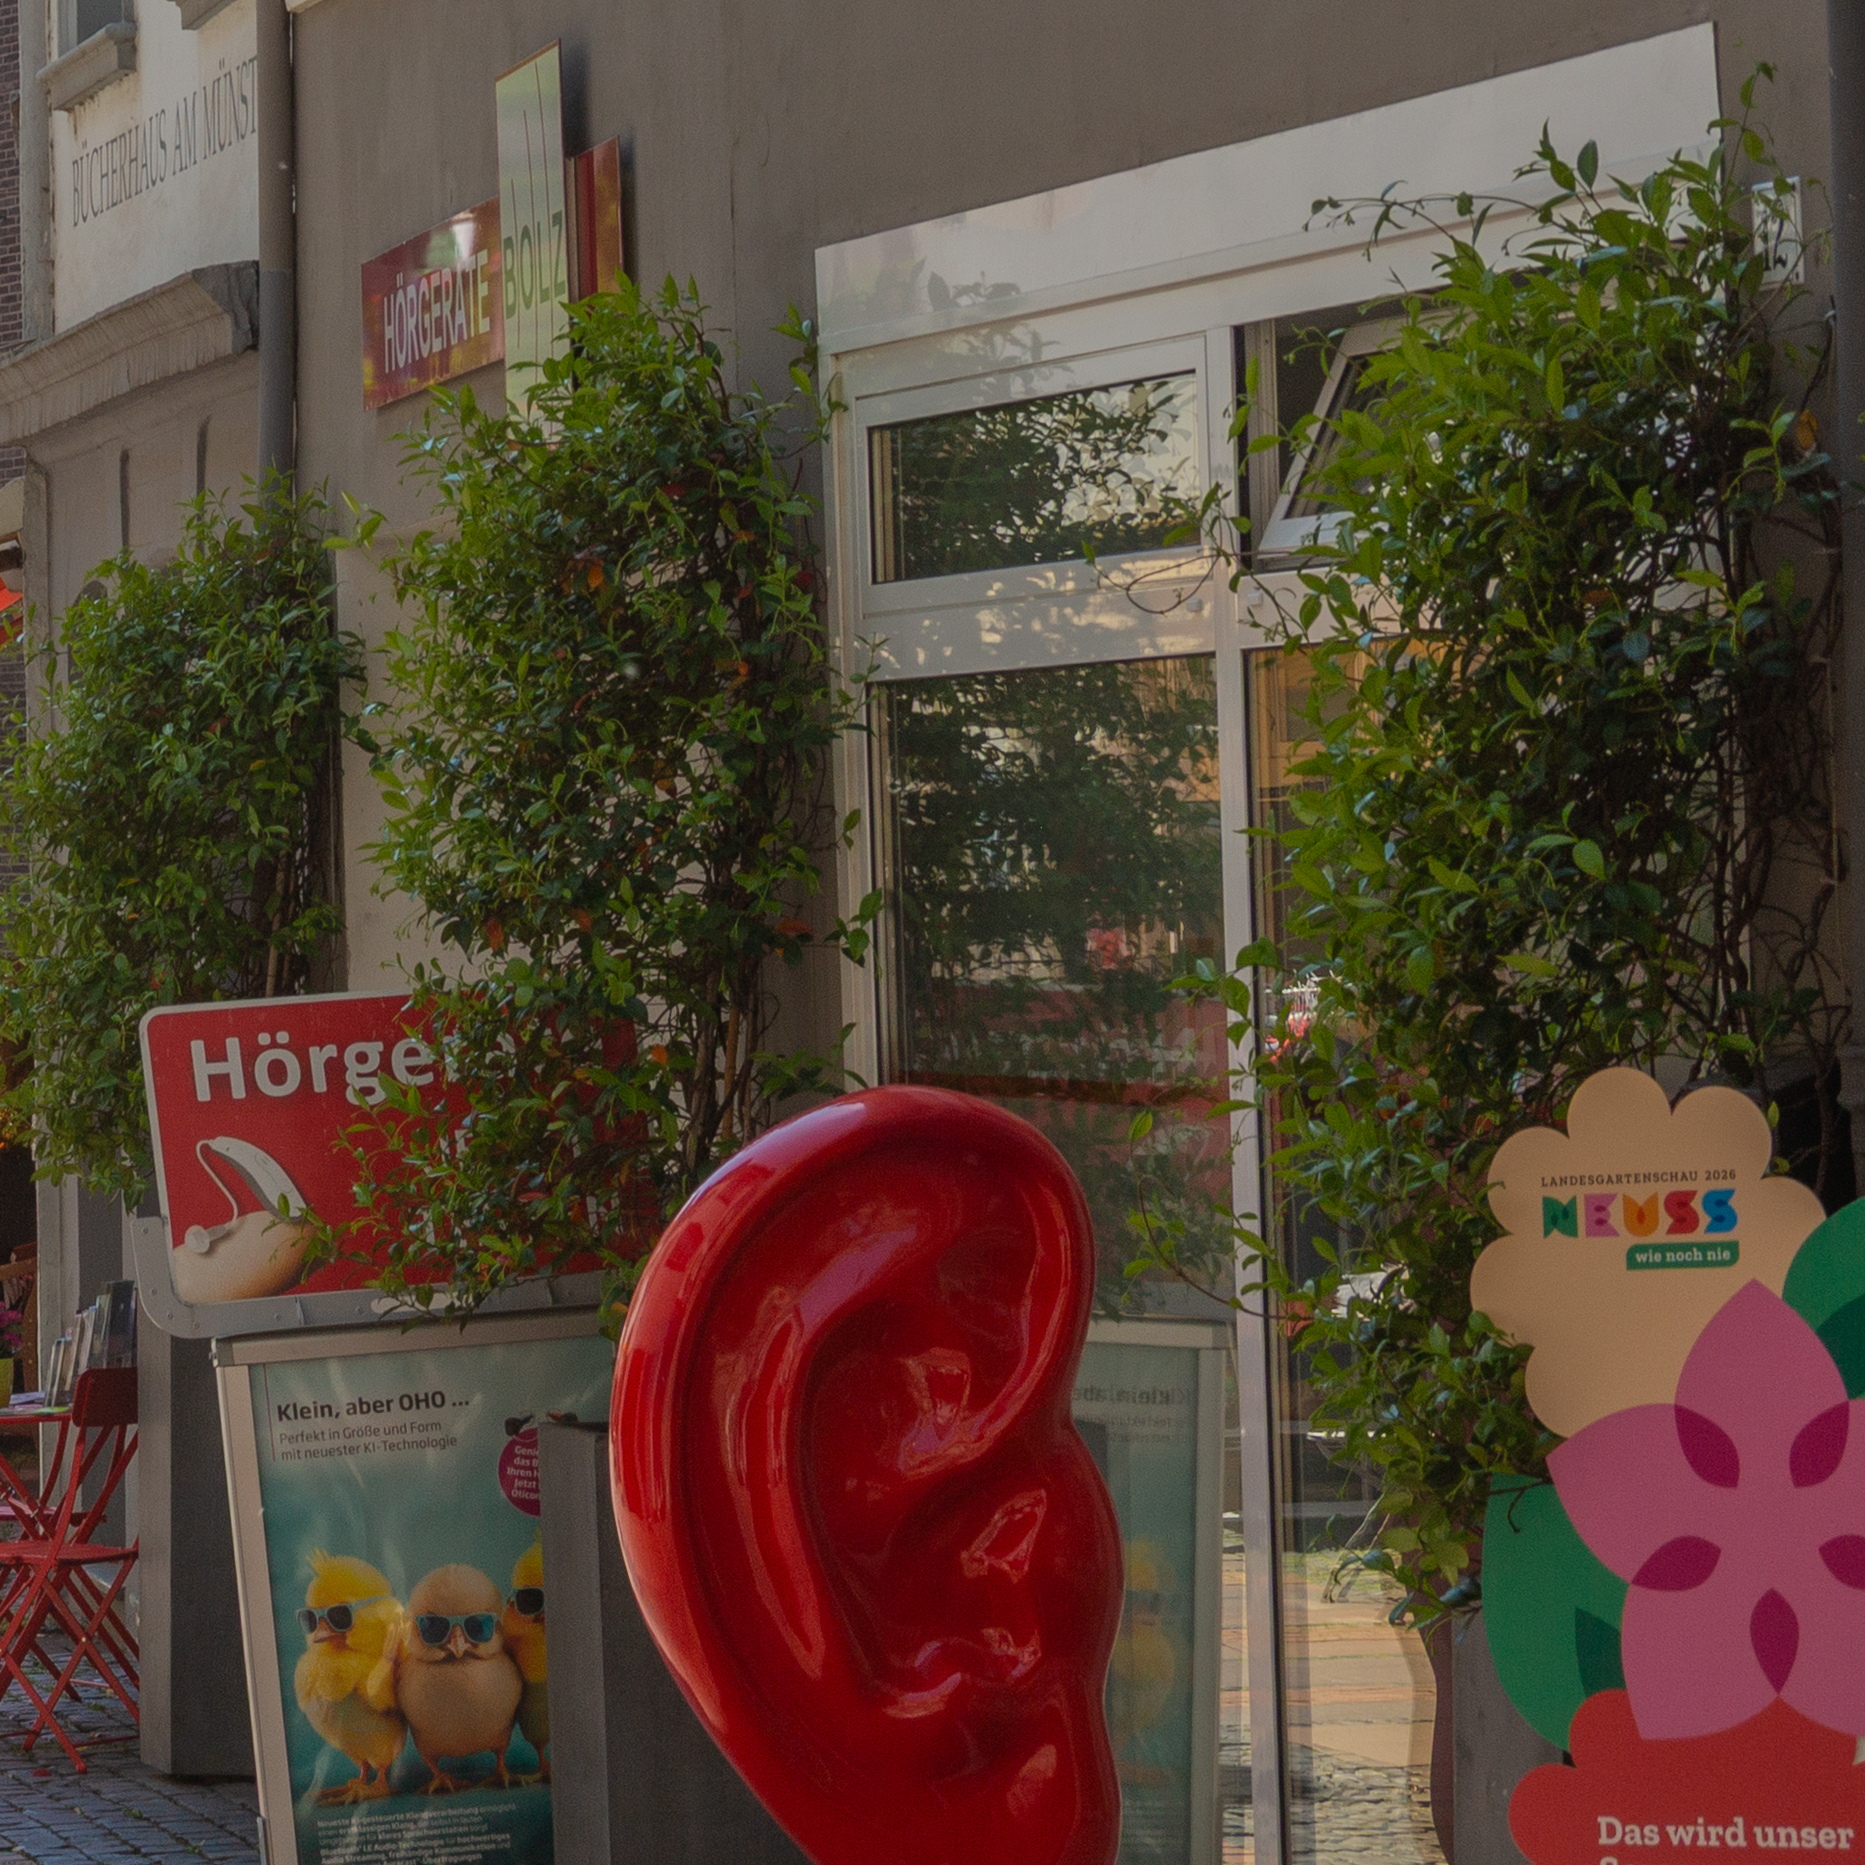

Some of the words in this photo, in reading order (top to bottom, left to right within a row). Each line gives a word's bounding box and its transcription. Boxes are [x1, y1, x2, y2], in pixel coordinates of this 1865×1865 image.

[72, 108, 167, 227] BÜCHERHAUS
[172, 91, 197, 175] AM
[202, 57, 257, 160] MÜNST
[502, 209, 565, 319] BOLZ
[1541, 1170, 1698, 1187] LANDESGARTENSCHAU
[1704, 1169, 1736, 1181] 2026
[1542, 1188, 1738, 1239] NEUSS
[1635, 1249, 1662, 1263] wie
[1666, 1247, 1703, 1262] noch
[1707, 1247, 1731, 1261] nie
[277, 1400, 340, 1423] Klein,
[345, 1397, 394, 1416] aber
[399, 1390, 446, 1411] OHO
[279, 1430, 326, 1446] Perfekt
[328, 1427, 340, 1441] in
[342, 1424, 380, 1441] Größe
[383, 1422, 407, 1436] und
[411, 1420, 442, 1434] Form
[281, 1447, 301, 1461] mit
[304, 1444, 360, 1459] neuester
[364, 1435, 457, 1454] KI-Technologie
[1597, 1816, 1660, 1846] Das
[1666, 1816, 1747, 1847] wird
[1753, 1825, 1854, 1849] unser
